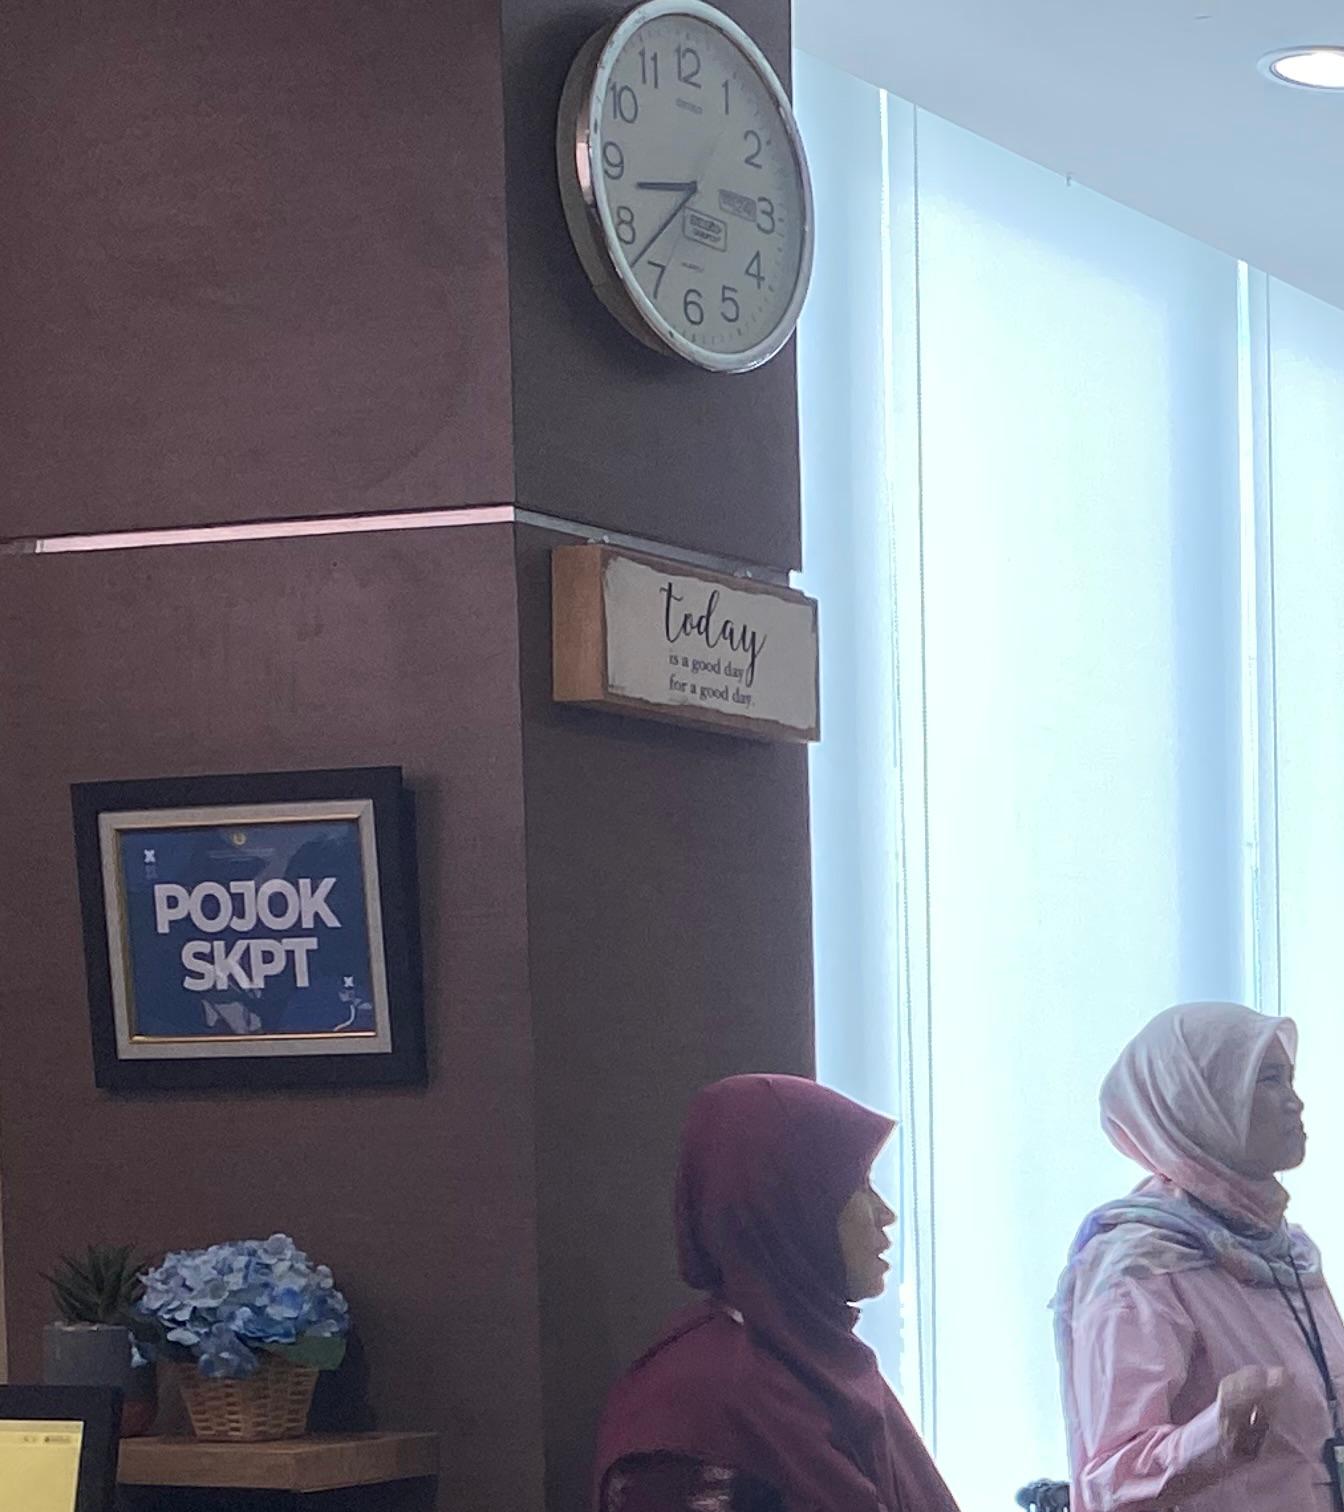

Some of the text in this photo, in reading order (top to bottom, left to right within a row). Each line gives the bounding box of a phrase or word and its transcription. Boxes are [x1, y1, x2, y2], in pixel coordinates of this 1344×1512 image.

[638, 46, 659, 90] 11
[675, 44, 703, 90] 12
[609, 81, 639, 124] 10
[720, 78, 730, 116] 1
[602, 140, 625, 180] 9
[742, 128, 763, 170] 2
[616, 205, 636, 245] 8
[756, 195, 776, 235] 3
[647, 259, 666, 300] 7
[744, 250, 766, 290] 4
[682, 287, 704, 326] 6
[720, 284, 740, 323] 5
[659, 581, 768, 688] today
[669, 654, 745, 683] is a good day
[669, 673, 688, 693] for
[689, 683, 697, 694] a
[700, 684, 730, 701] good
[153, 876, 342, 935] POJOK
[181, 936, 319, 992] SKPT
